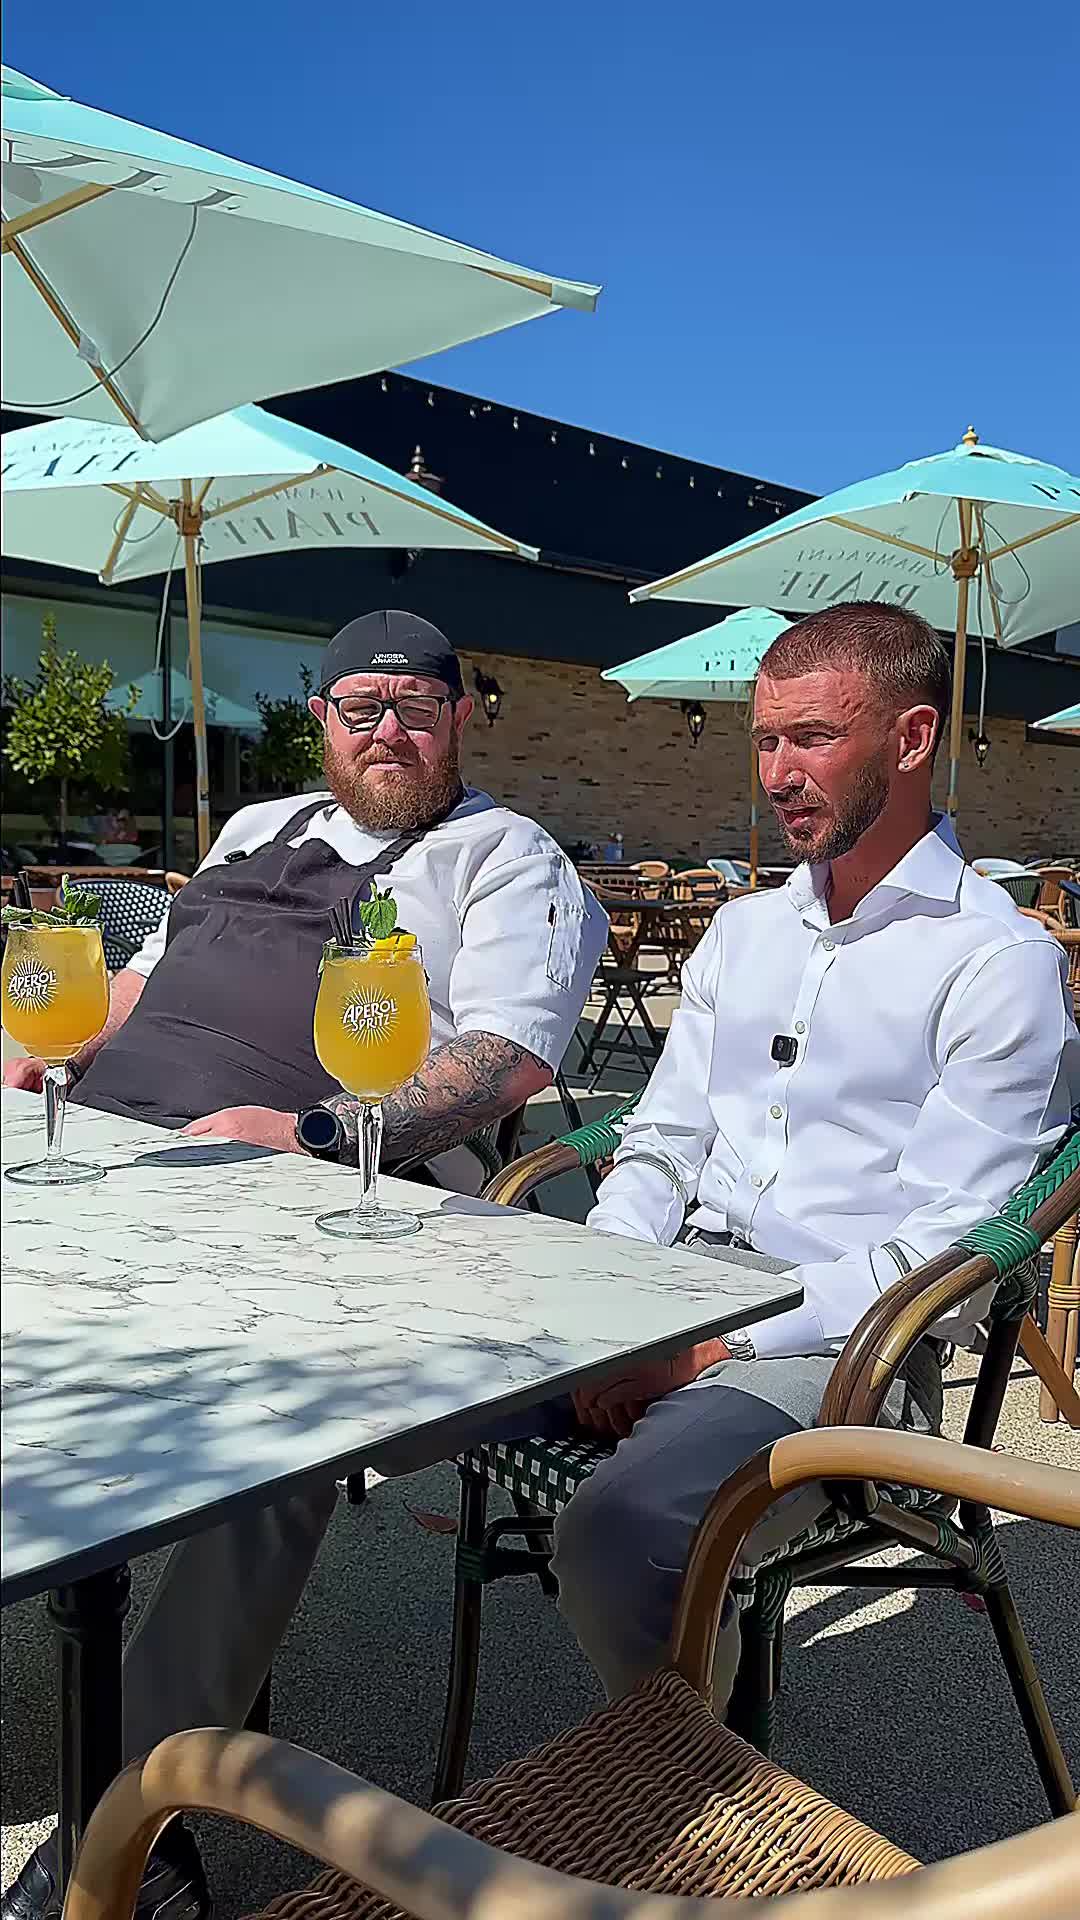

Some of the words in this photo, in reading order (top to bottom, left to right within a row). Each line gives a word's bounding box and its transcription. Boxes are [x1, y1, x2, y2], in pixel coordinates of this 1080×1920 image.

[7, 970, 57, 993] APEROL
[10, 984, 48, 1000] SPRITZ
[342, 998, 398, 1024] APEROL
[350, 1013, 390, 1032] SPRITZ
